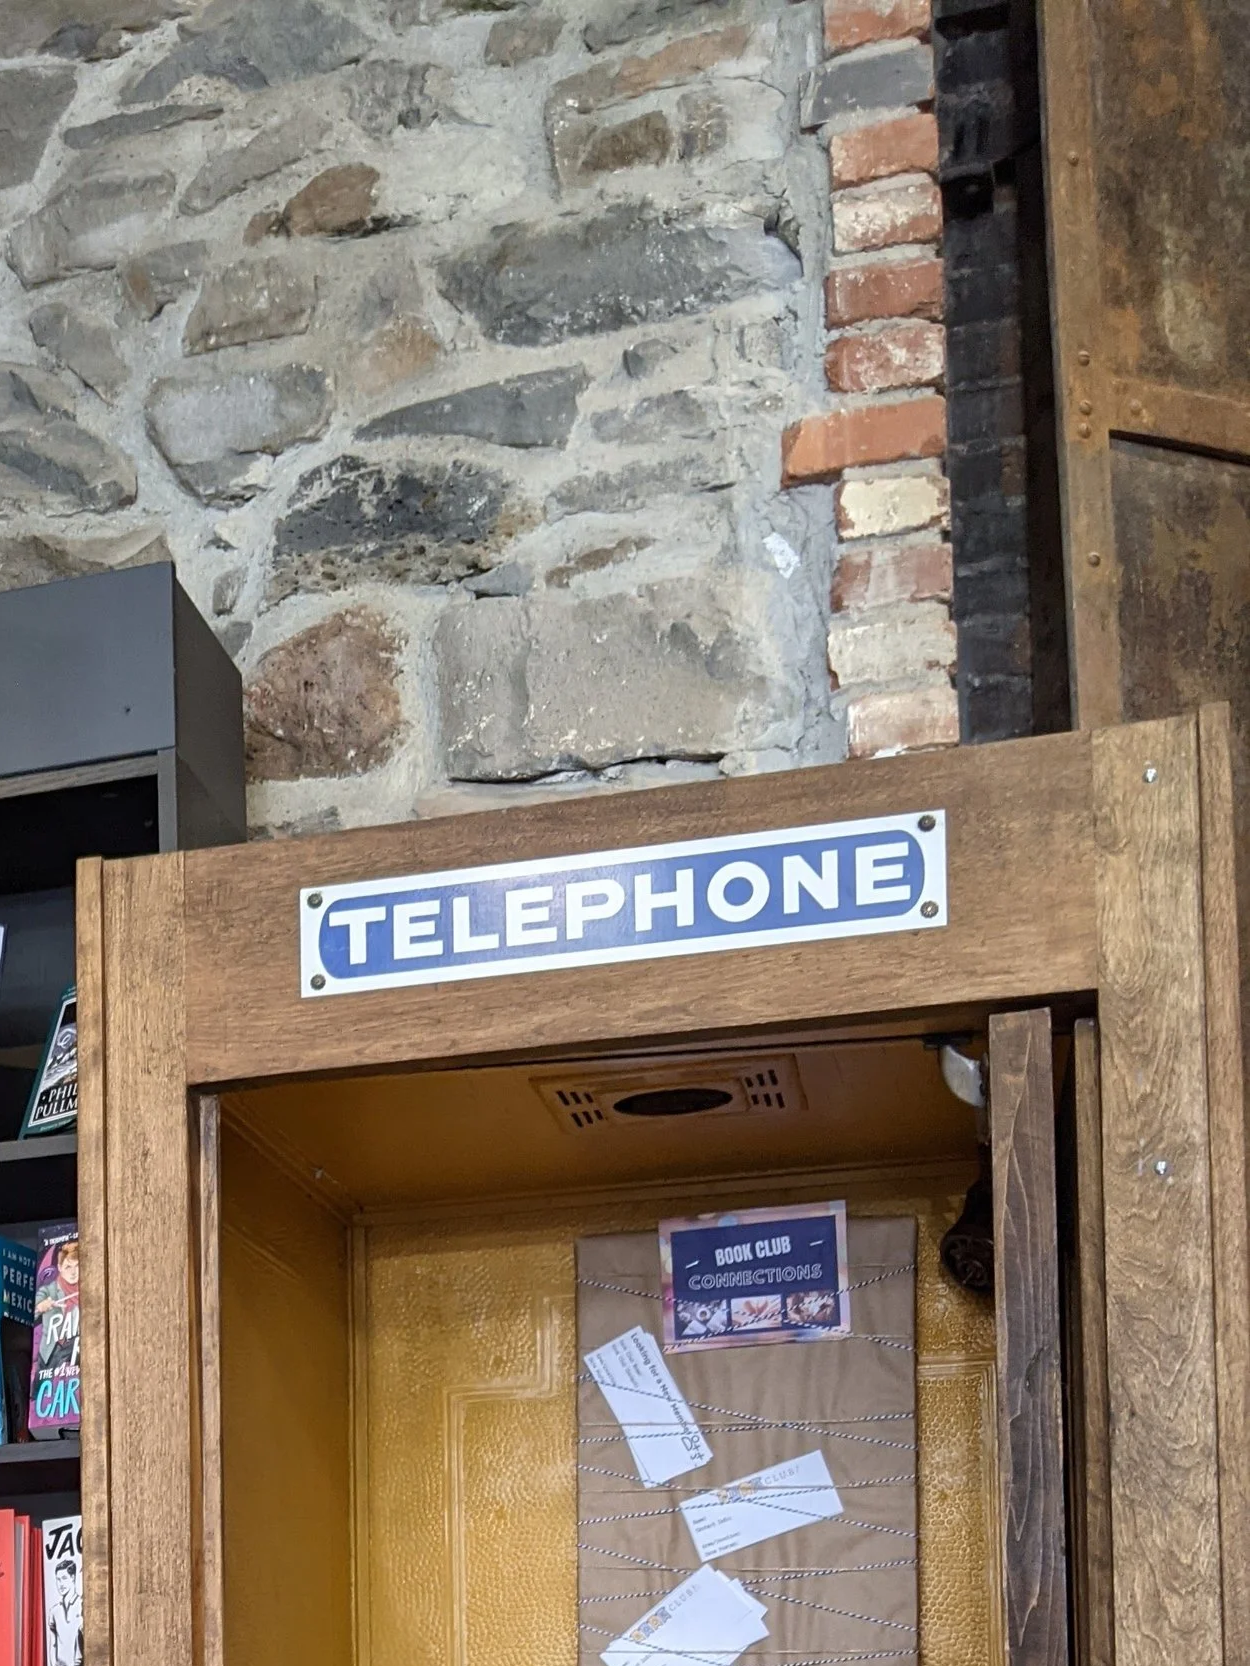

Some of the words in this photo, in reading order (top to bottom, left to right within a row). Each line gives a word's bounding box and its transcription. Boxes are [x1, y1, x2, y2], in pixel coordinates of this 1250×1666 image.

[328, 841, 913, 965] TELEPHONE
[715, 1243, 753, 1267] BOOK
[754, 1236, 791, 1260] CLUB
[688, 1263, 823, 1290] CONNECTIONS
[631, 1332, 650, 1366] Looking
[649, 1365, 659, 1378] for
